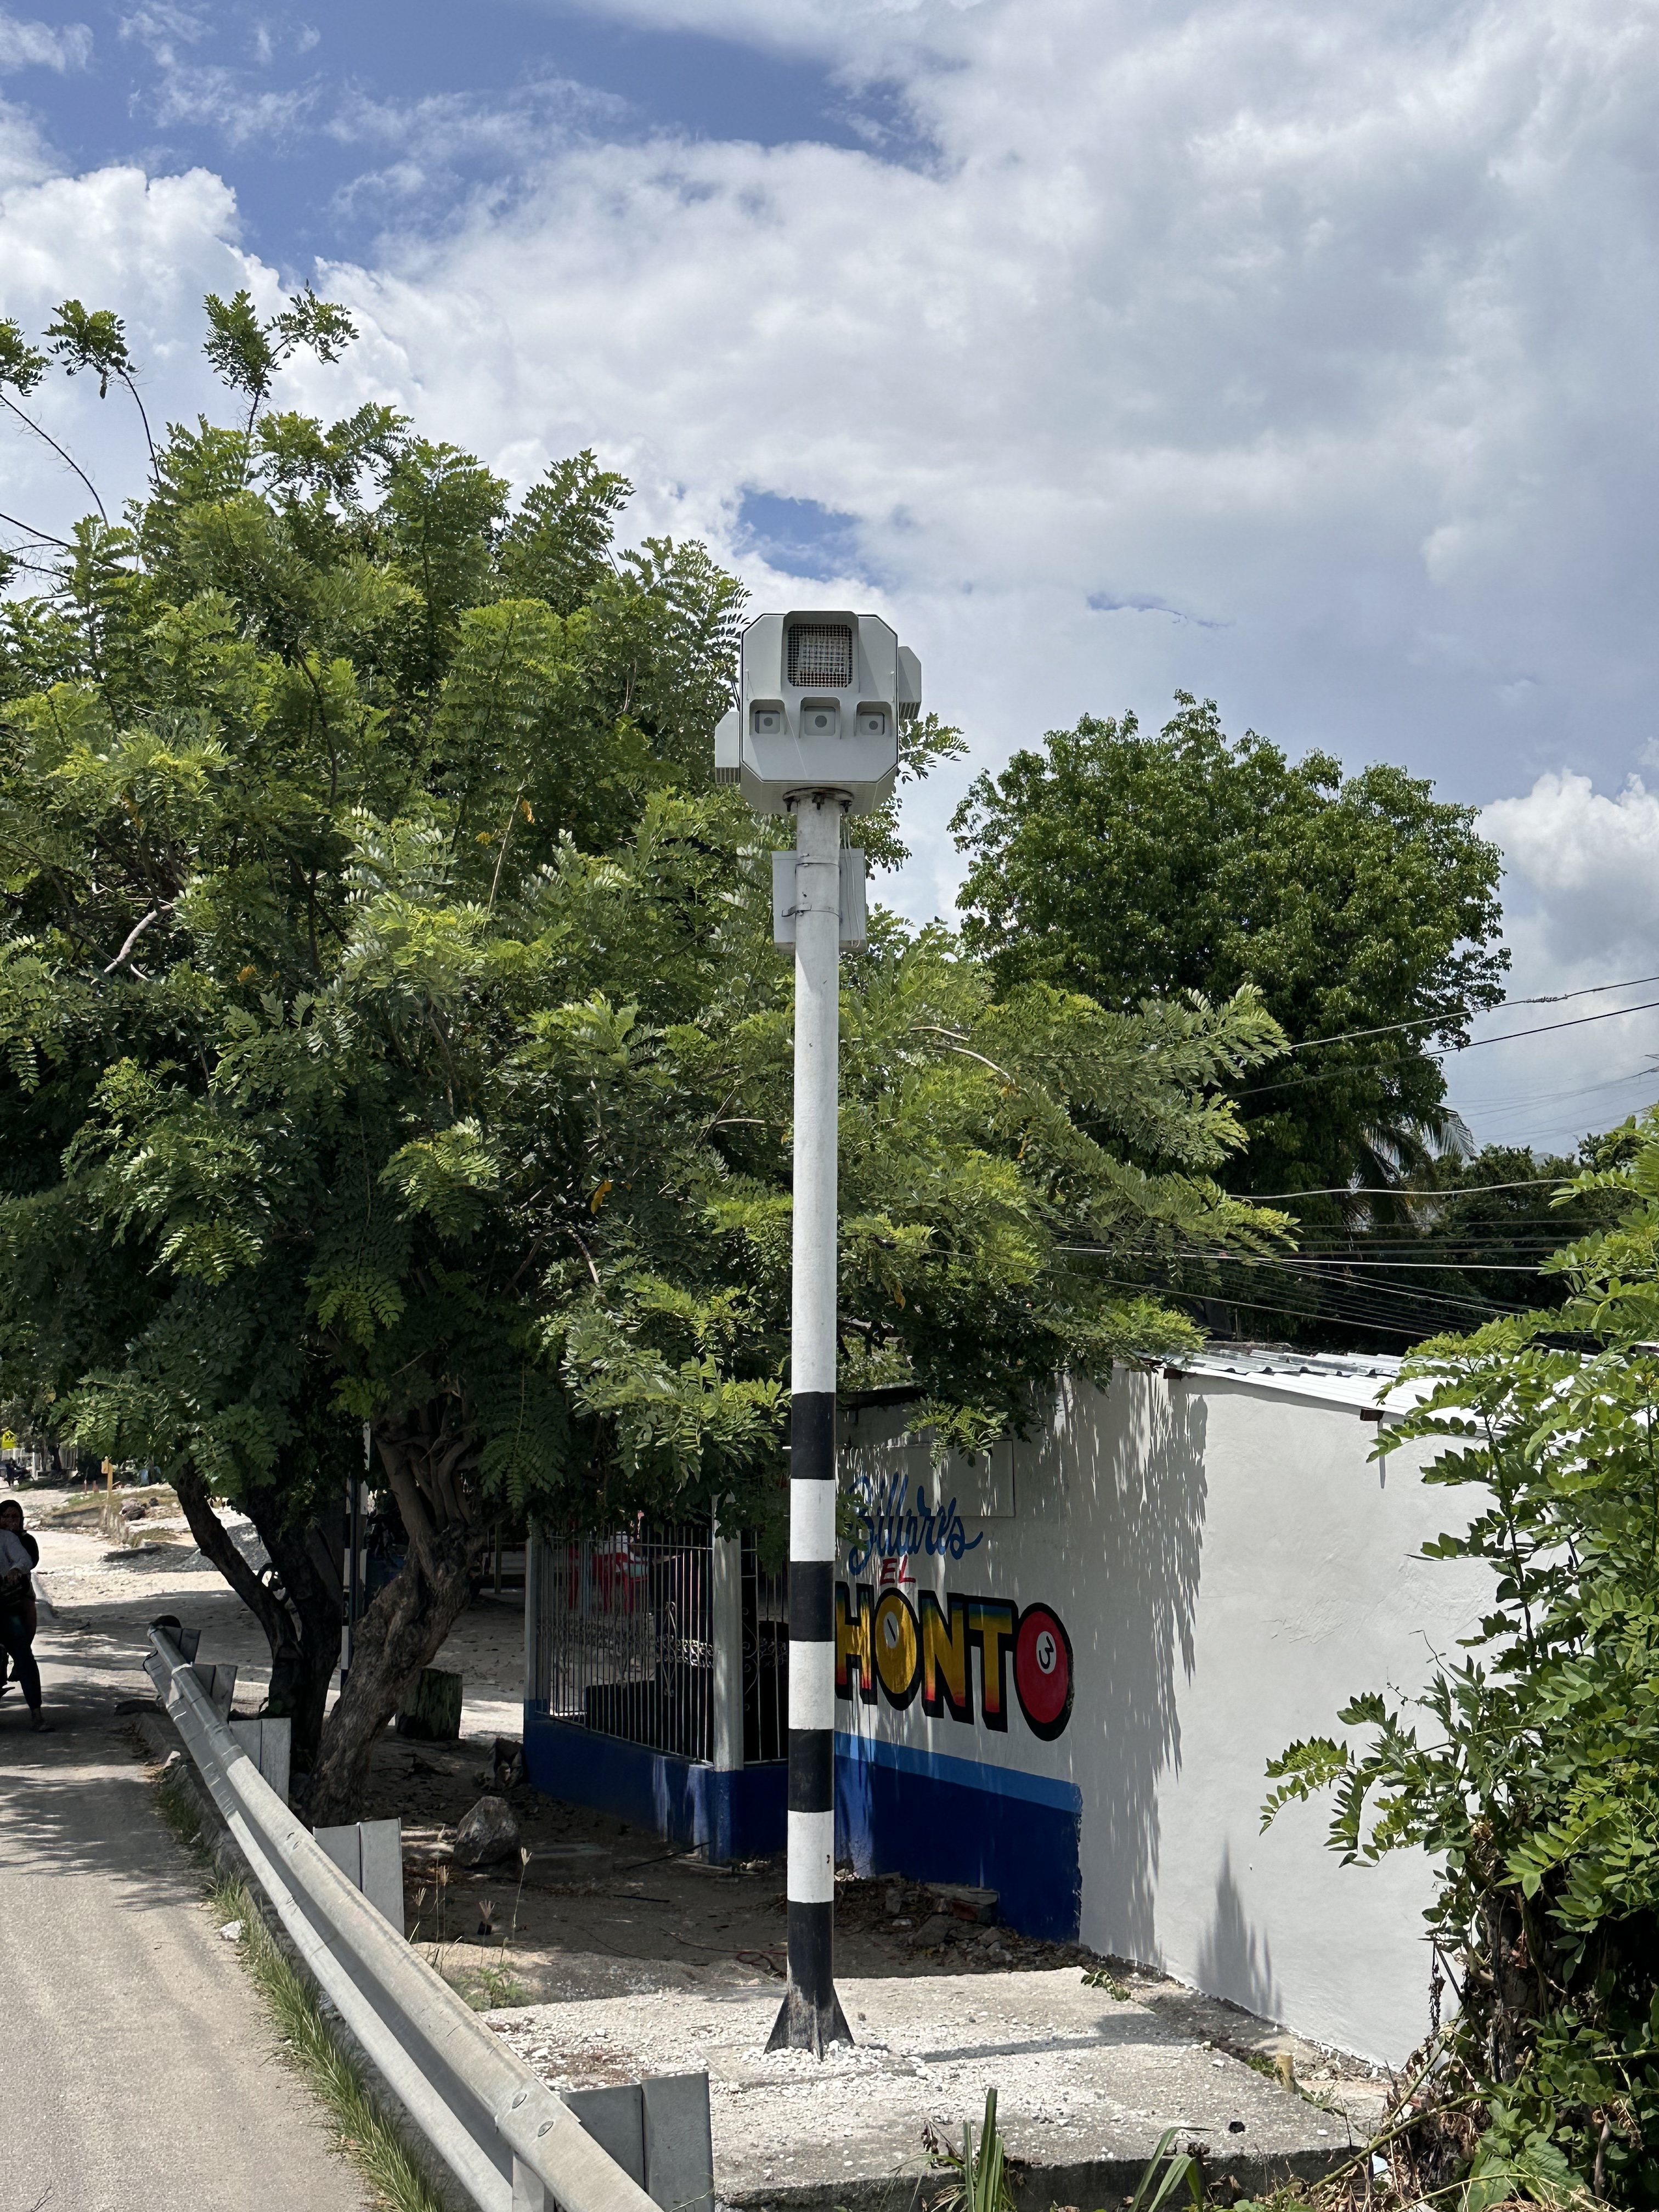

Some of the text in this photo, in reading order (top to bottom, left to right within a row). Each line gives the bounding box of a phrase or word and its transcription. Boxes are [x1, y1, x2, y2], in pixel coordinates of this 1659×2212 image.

[849, 1471, 984, 1576] Billares
[880, 1554, 916, 1585] EL
[835, 1581, 1074, 1741] HONTO
